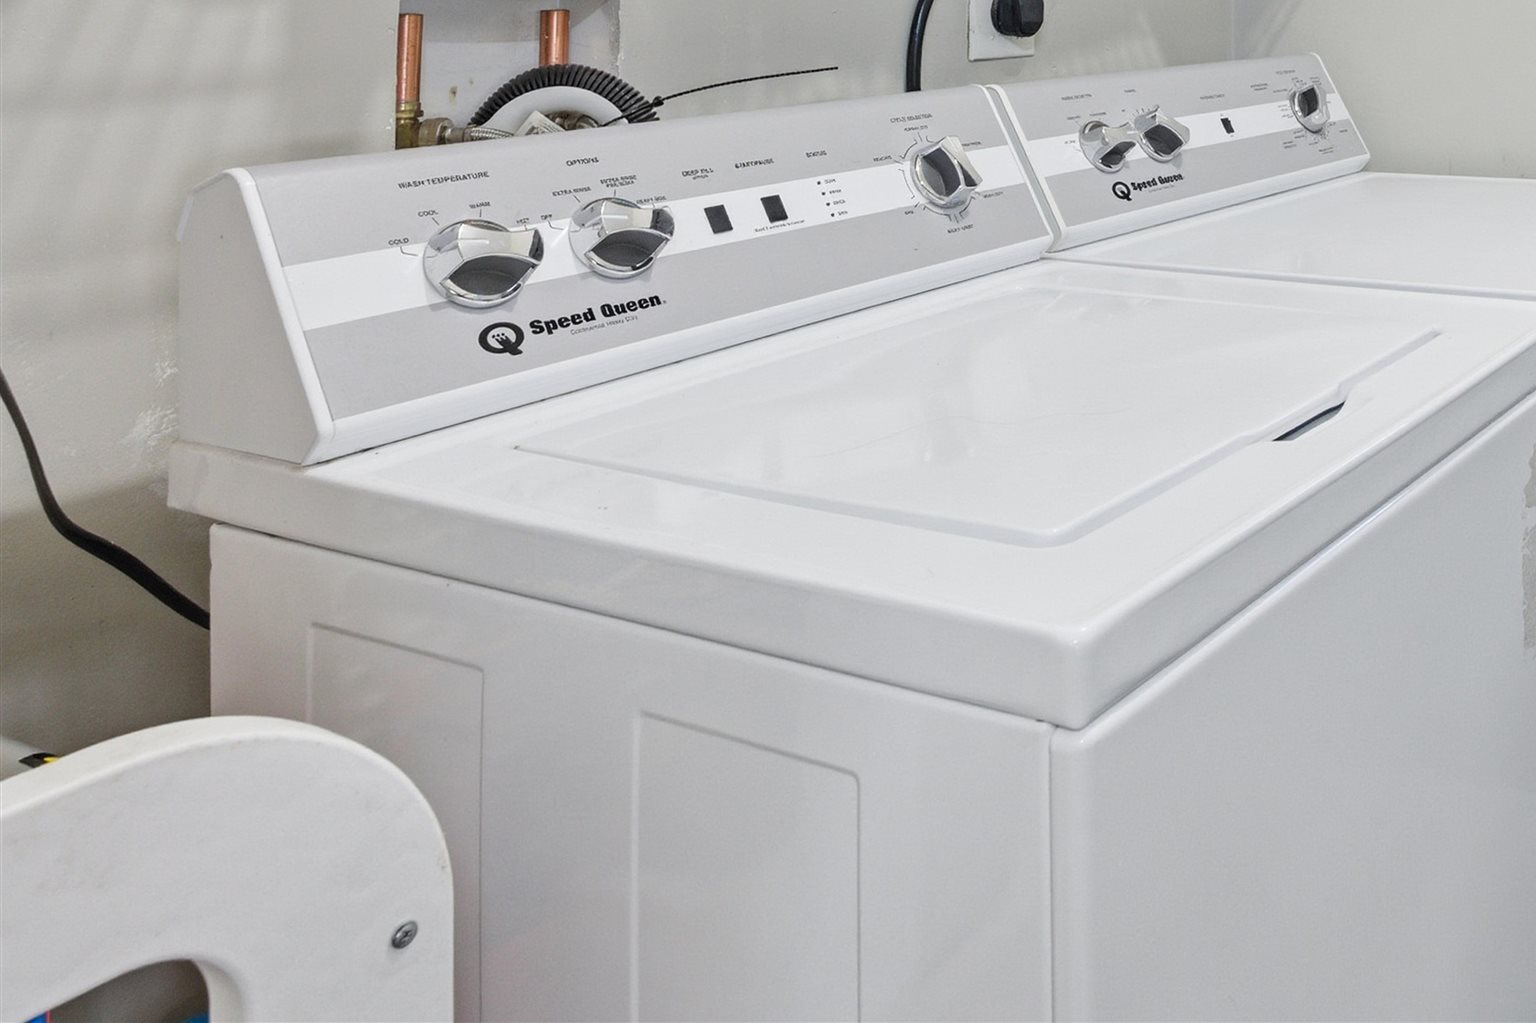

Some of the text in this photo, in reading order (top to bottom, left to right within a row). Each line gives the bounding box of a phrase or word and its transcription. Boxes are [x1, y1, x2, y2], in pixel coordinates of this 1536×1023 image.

[398, 171, 490, 189] WASH TEMPERATURE
[418, 209, 438, 217] COOL
[388, 237, 409, 246] COLD
[529, 307, 596, 335] Speed
[601, 295, 662, 318] Queen
